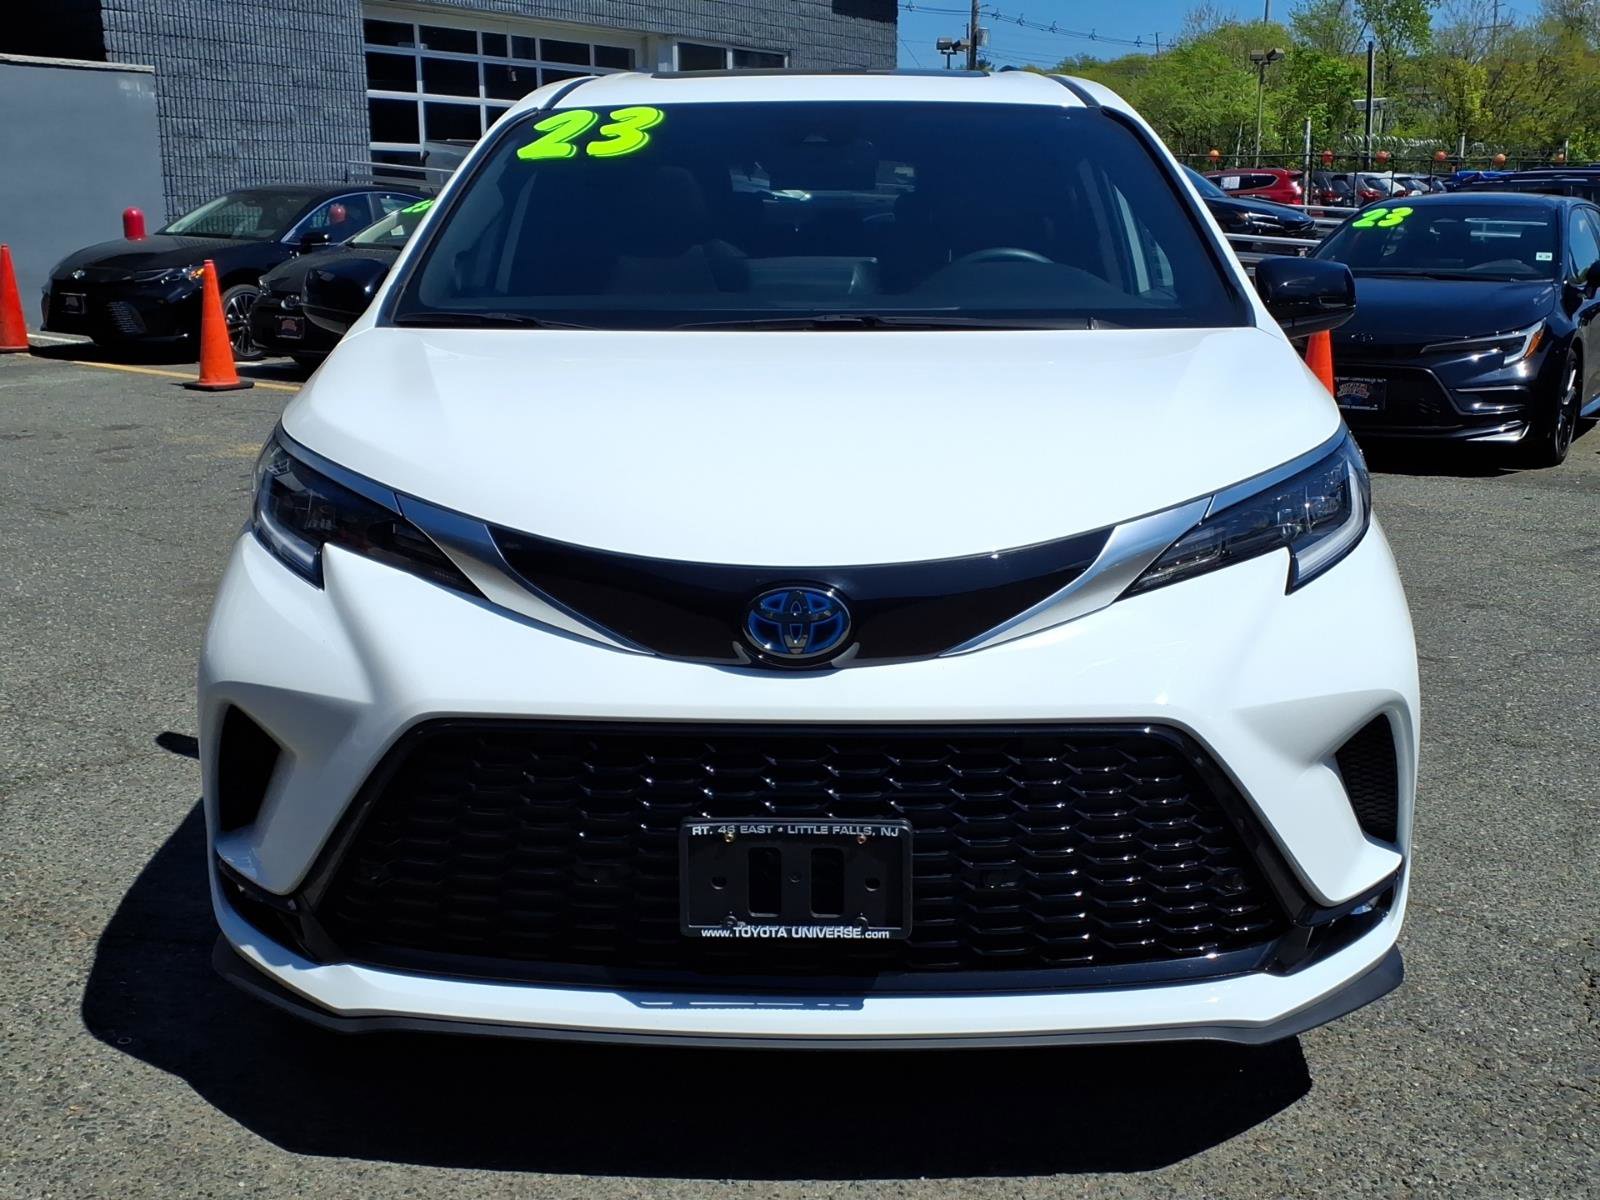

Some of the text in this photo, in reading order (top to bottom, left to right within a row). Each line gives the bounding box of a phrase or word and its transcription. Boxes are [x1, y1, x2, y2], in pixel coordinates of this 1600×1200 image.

[517, 106, 664, 159] 23
[1352, 207, 1413, 227] 23
[692, 825, 713, 836] RT.
[740, 825, 773, 834] EAST
[787, 825, 828, 835] LITTLE
[832, 825, 876, 837] FALLS,
[880, 826, 899, 837] NJ
[701, 926, 890, 939] www.TOYOTA UNIVERSE.com
